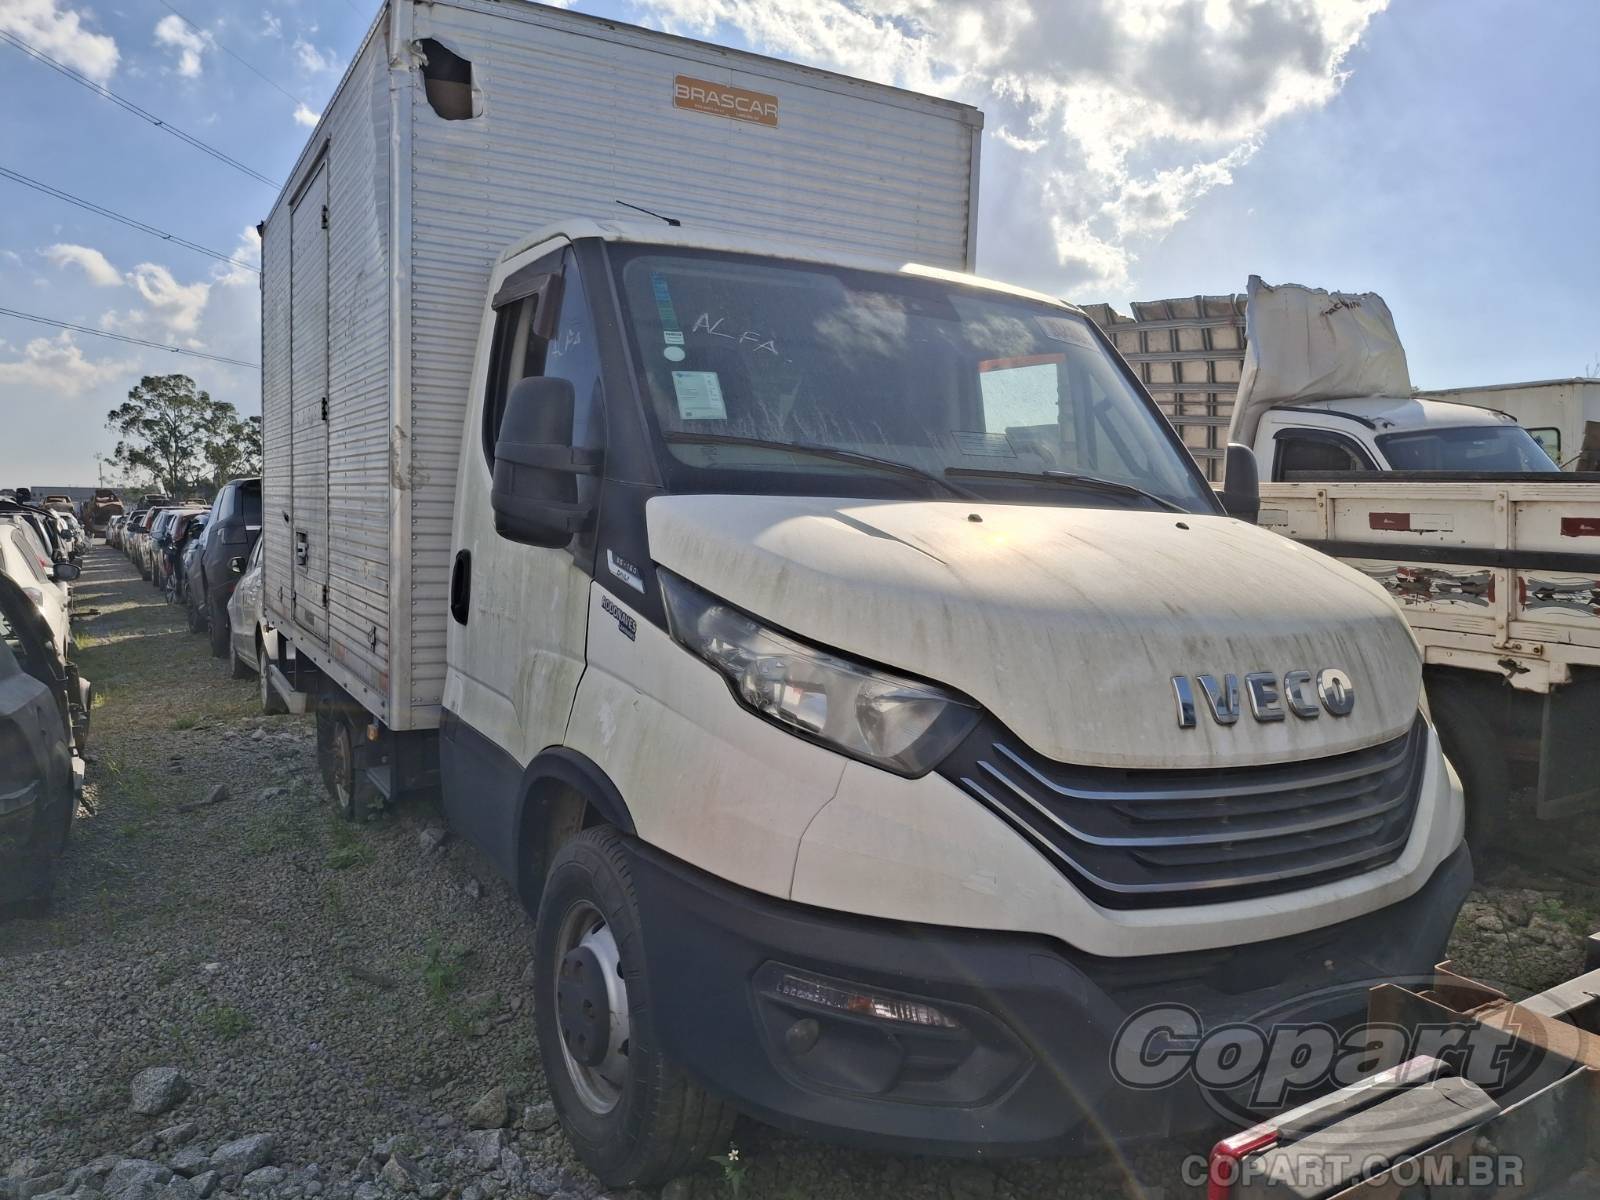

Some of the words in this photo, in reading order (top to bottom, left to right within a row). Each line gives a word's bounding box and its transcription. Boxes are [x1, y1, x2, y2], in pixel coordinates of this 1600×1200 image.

[674, 83, 778, 118] BRASCAR
[692, 312, 779, 355] ALFA
[1170, 668, 1355, 729] IVECO
